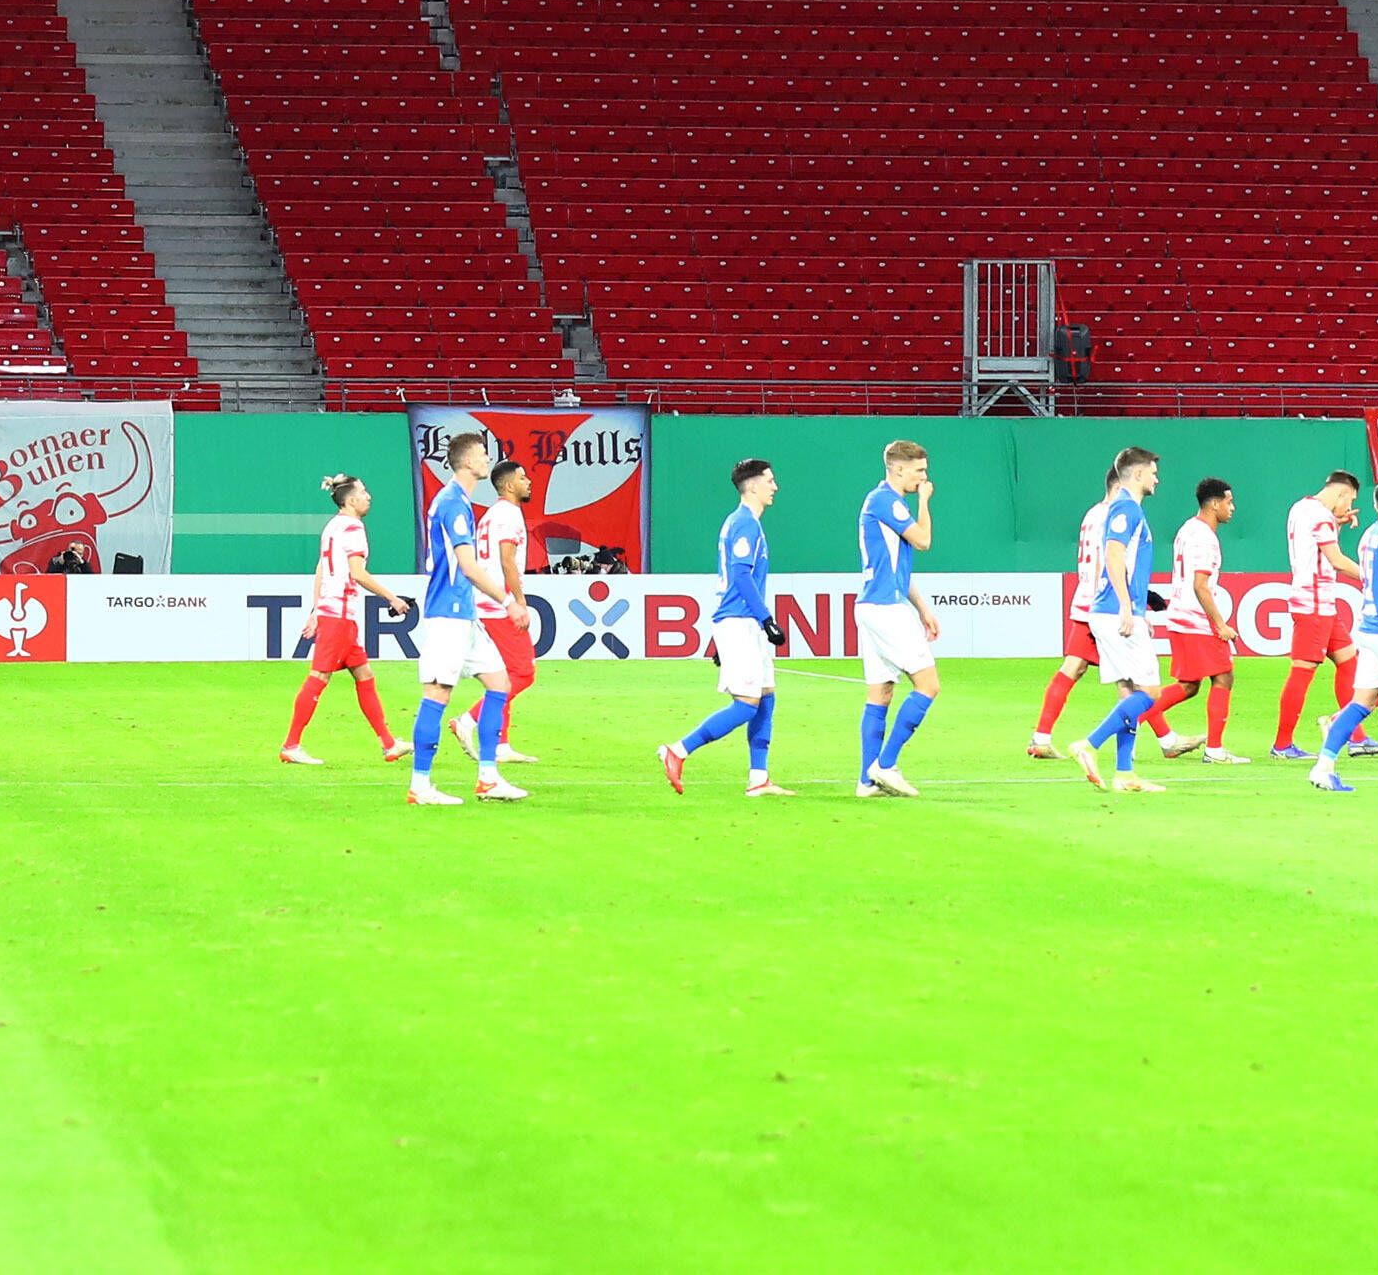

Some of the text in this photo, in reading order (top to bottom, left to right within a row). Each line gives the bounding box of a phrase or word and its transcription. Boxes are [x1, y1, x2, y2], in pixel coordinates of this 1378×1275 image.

[416, 423, 515, 471] Hly
[106, 596, 207, 608] TARGO BANK
[931, 595, 1031, 606] TARGO BANK
